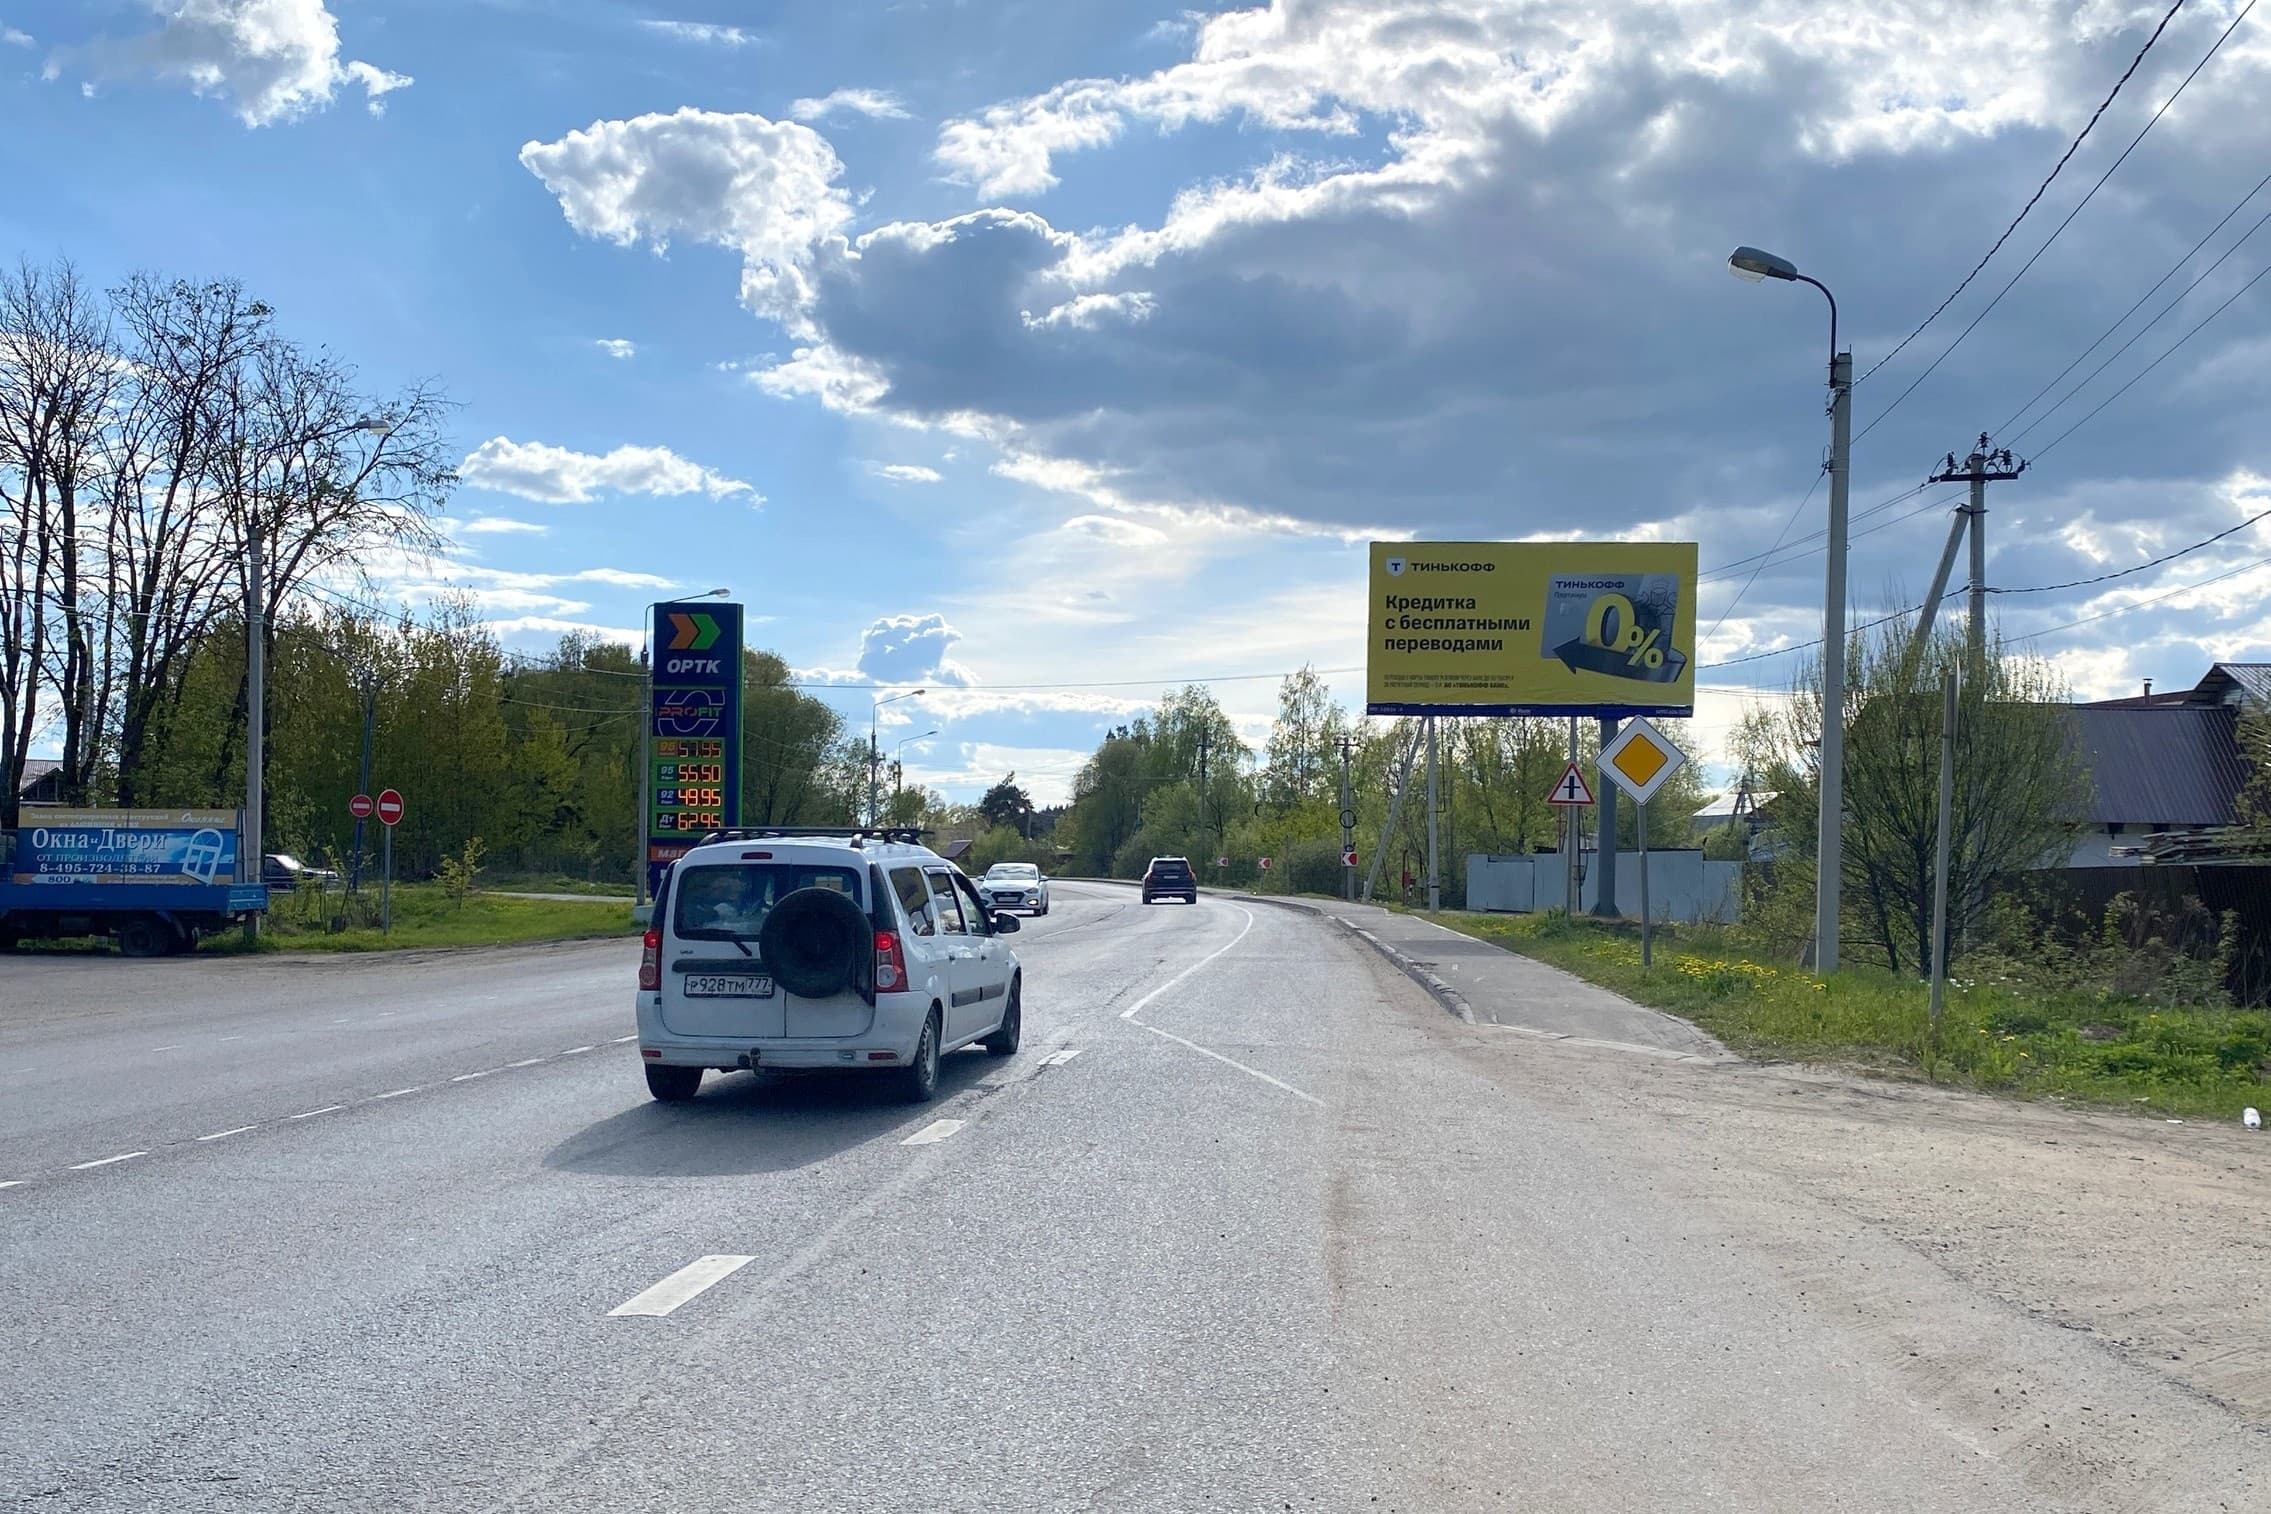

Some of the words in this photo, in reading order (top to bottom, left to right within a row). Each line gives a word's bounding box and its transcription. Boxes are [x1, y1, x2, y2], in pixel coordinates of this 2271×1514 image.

[1410, 562, 1496, 573] ТИНЬКОФФ
[1555, 580, 1626, 590] ТИНЬКОФФ
[1385, 594, 1477, 612] Кредитка
[1385, 617, 1396, 630] с
[1400, 613, 1531, 632] бесплатными
[1585, 593, 1664, 669] 0%
[1384, 636, 1503, 653] переводами
[666, 658, 722, 674] ОРТК
[658, 706, 724, 717] PROFIT
[660, 765, 675, 775] 95
[678, 764, 721, 783] 55.50
[660, 790, 675, 799] 92
[678, 788, 721, 807] 49.95
[32, 828, 89, 849] Окна
[96, 829, 168, 853] Двери
